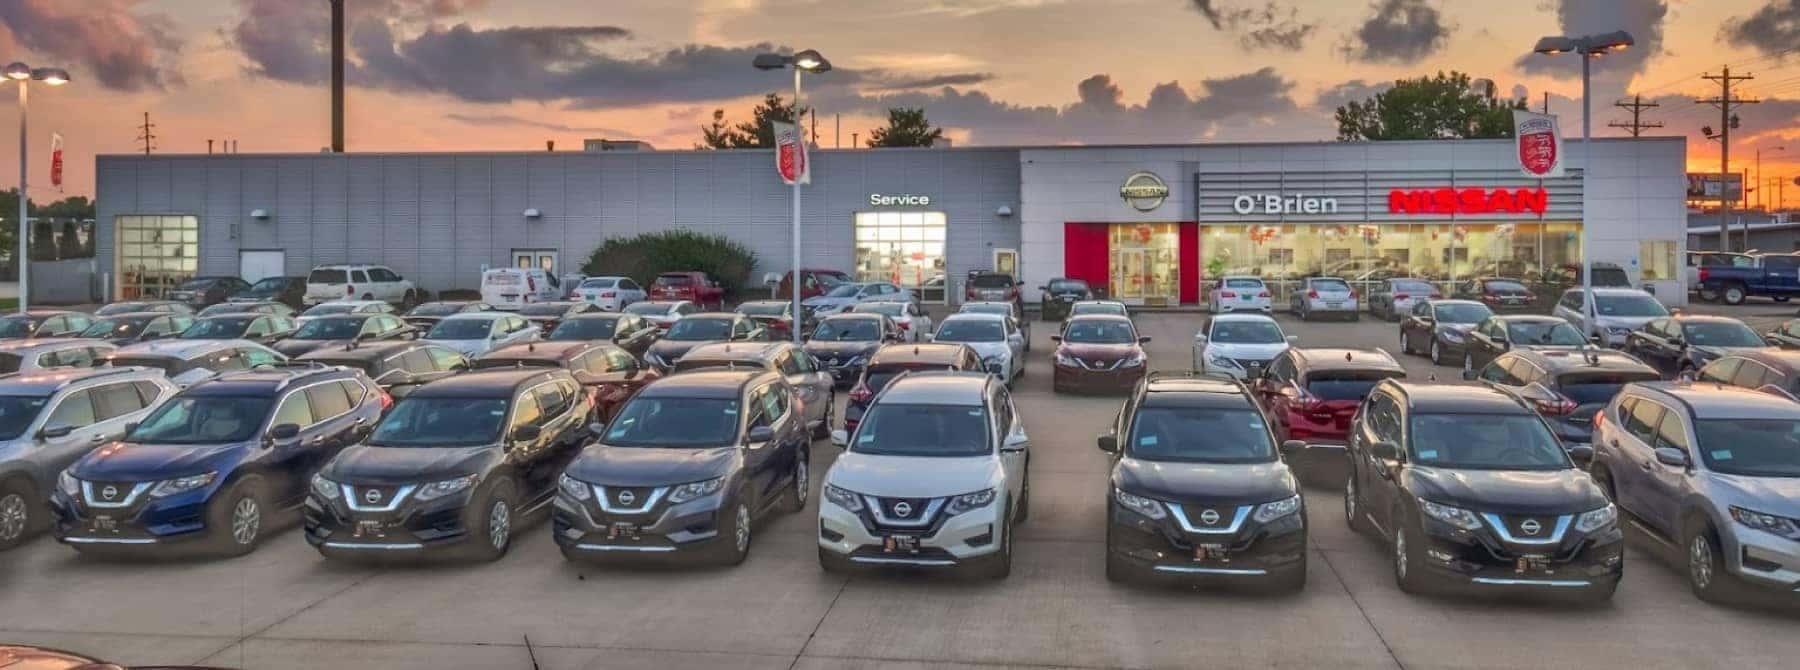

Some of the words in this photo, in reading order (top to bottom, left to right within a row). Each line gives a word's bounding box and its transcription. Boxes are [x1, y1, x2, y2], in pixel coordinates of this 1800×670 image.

[870, 193, 929, 206] Service
[1234, 194, 1338, 214] O'Brien
[1388, 187, 1547, 214] NISSAN
